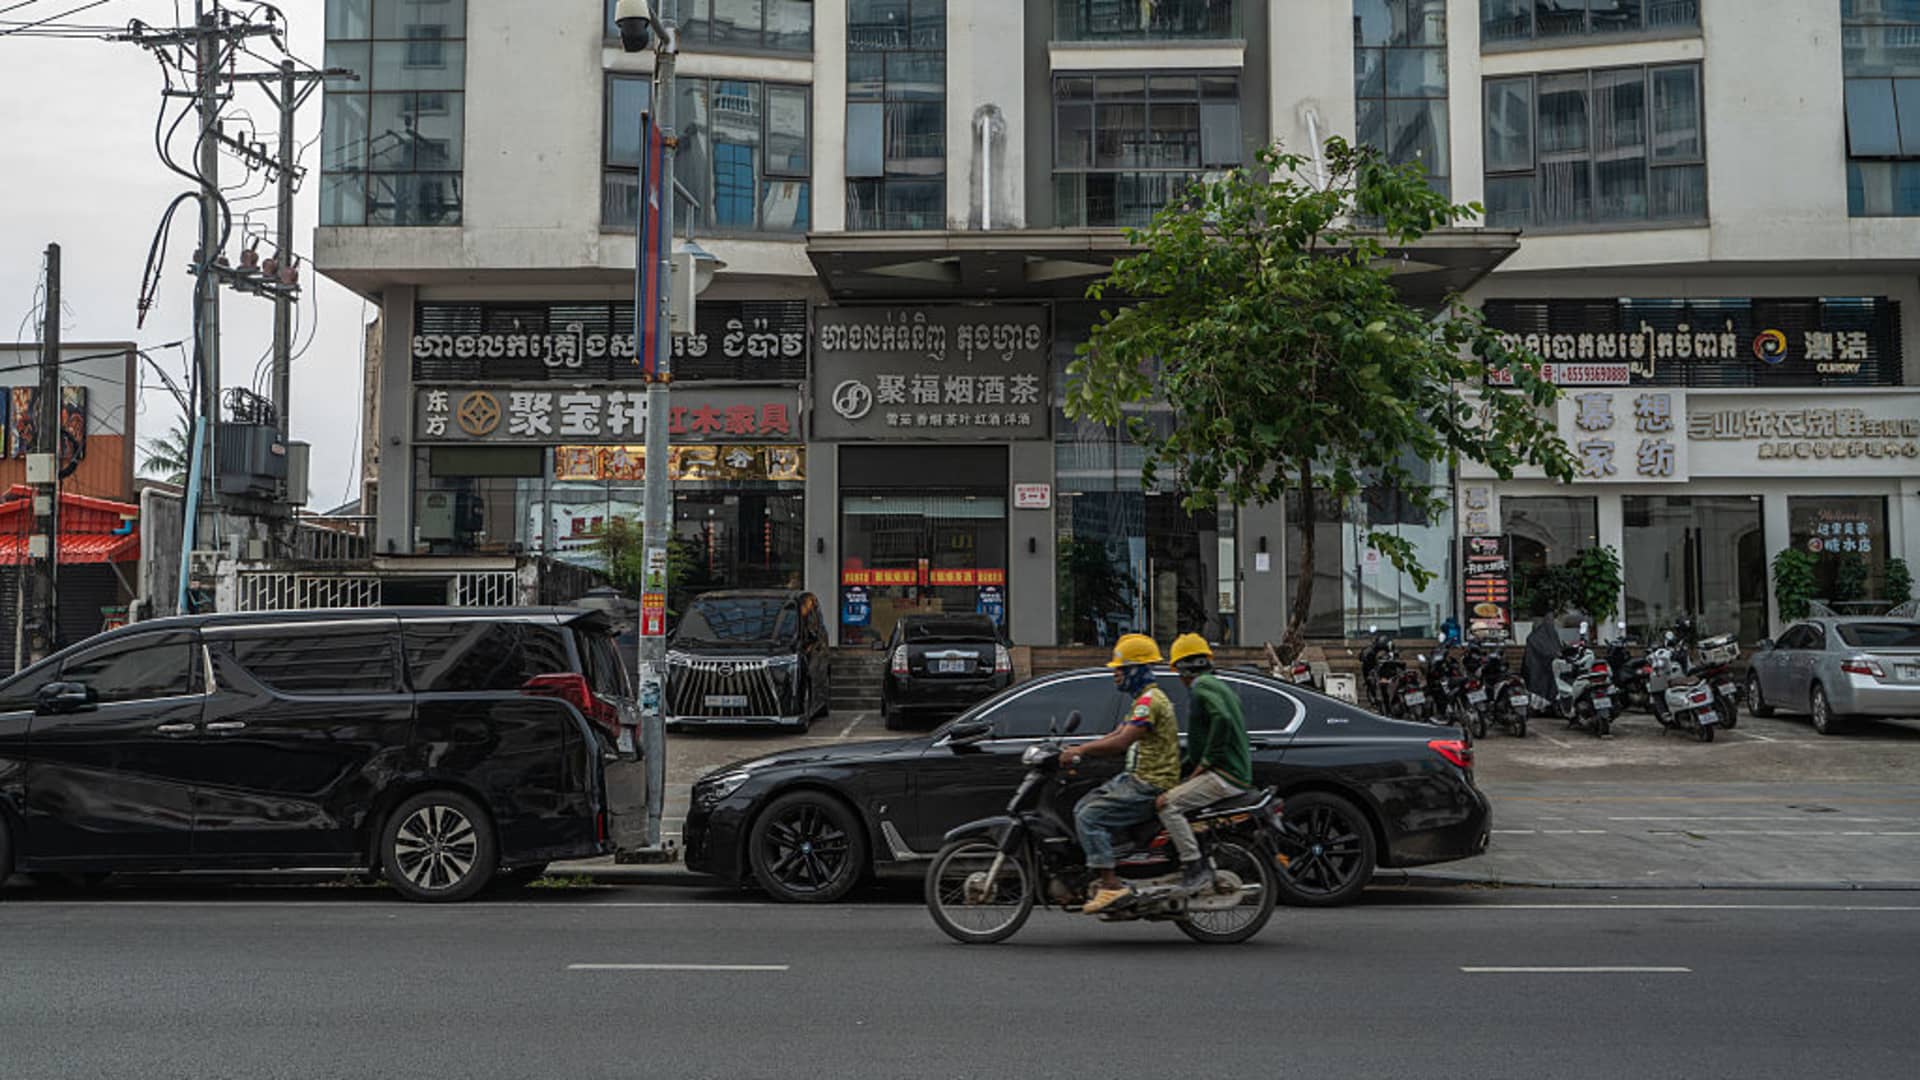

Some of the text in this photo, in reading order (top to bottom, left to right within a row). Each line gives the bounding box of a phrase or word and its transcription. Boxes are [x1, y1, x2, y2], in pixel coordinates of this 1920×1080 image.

[877, 373, 1039, 404] 聚福烟酒茶
[426, 389, 449, 437] 东方
[509, 391, 648, 436] 聚宝轩
